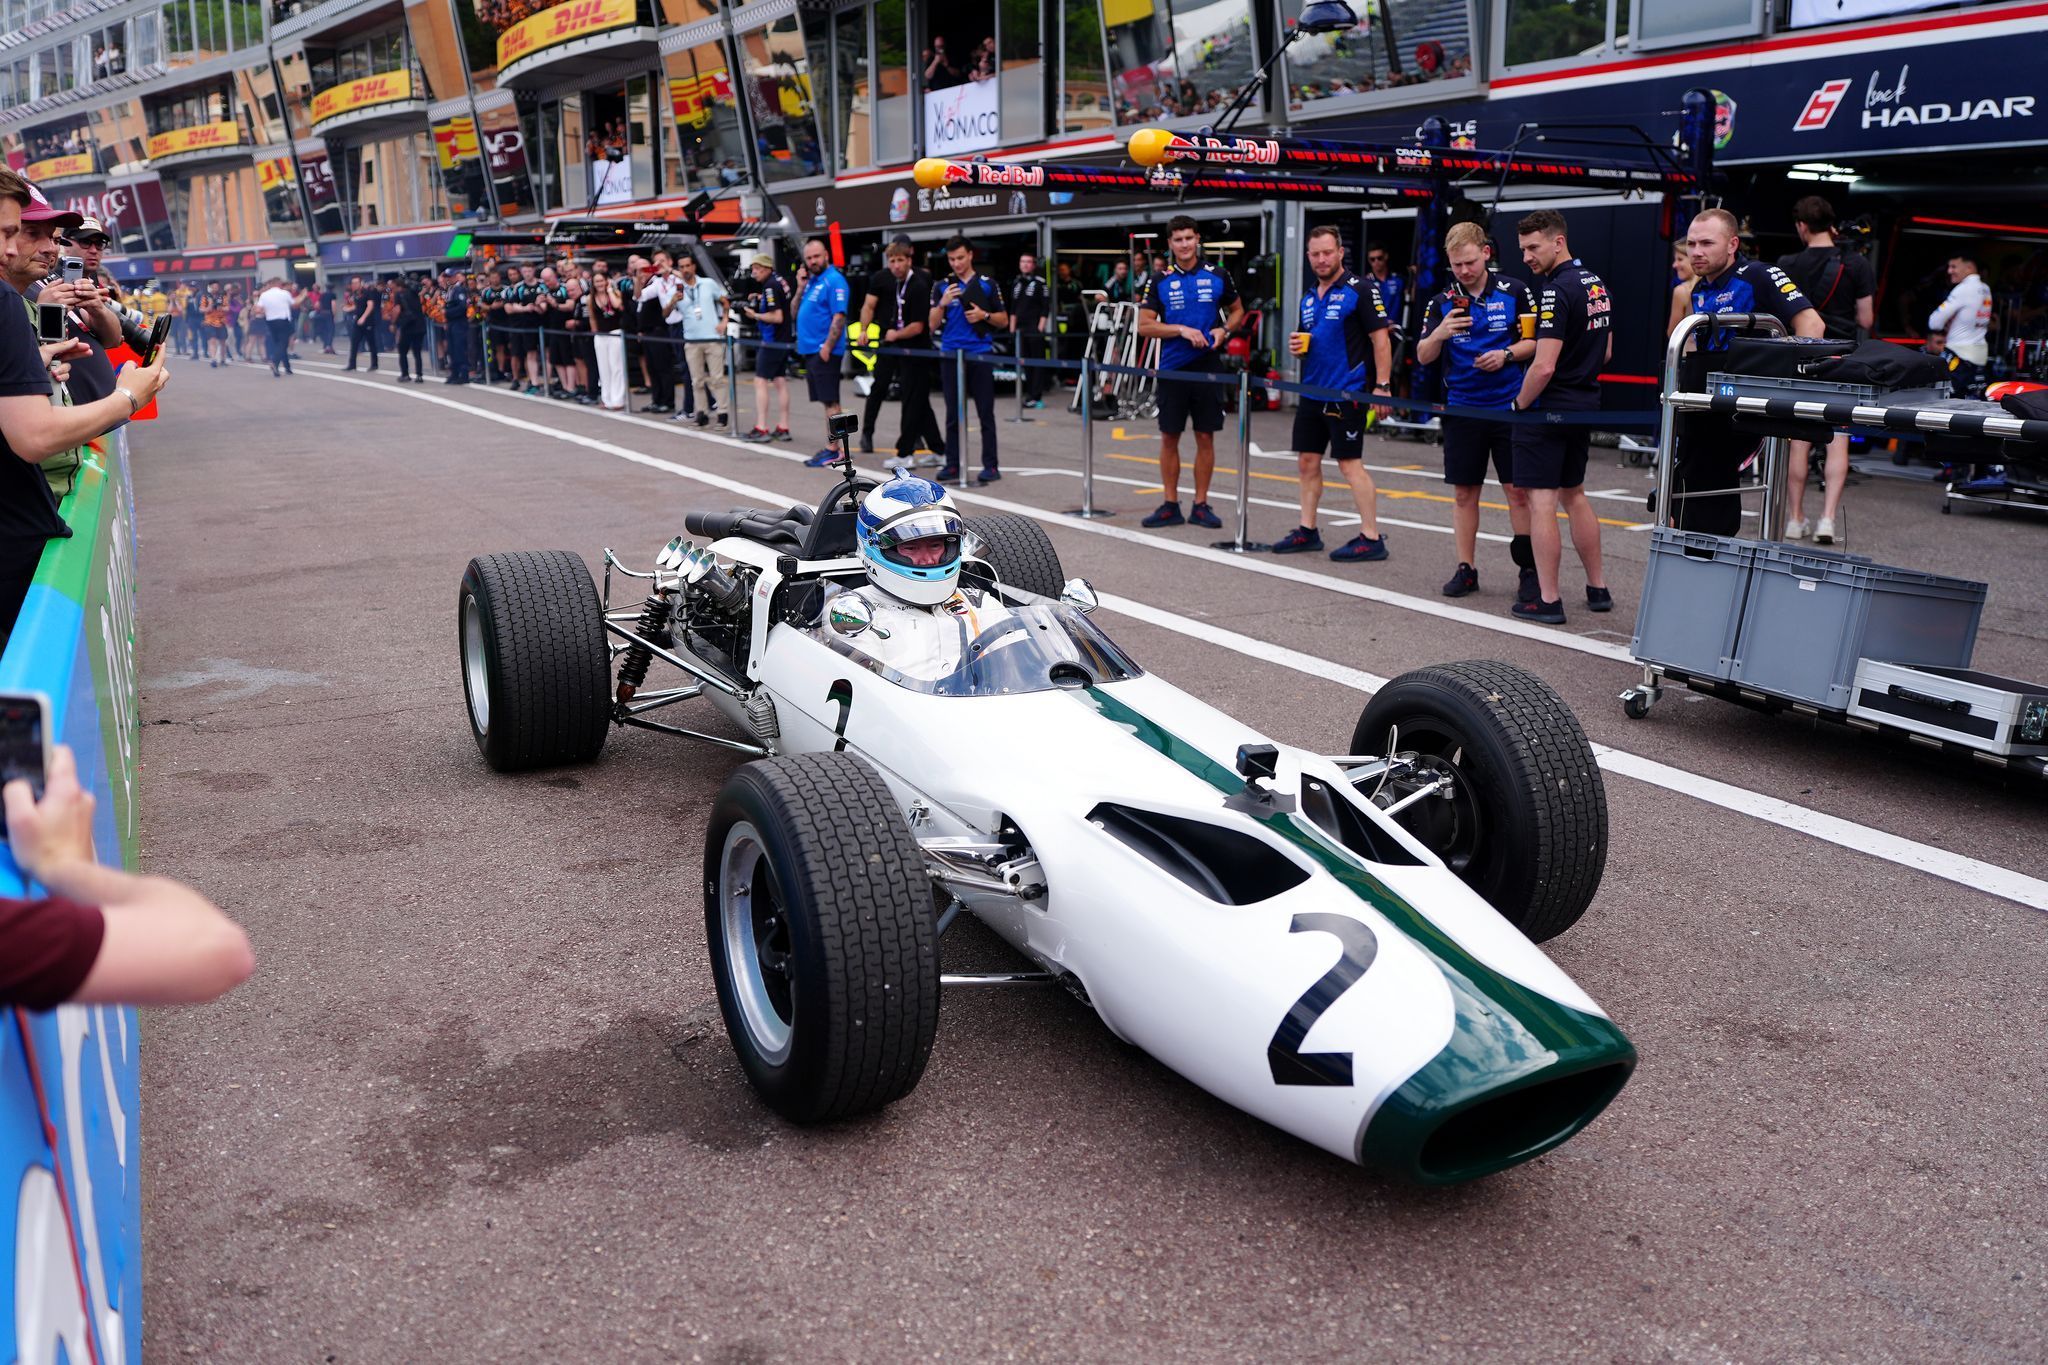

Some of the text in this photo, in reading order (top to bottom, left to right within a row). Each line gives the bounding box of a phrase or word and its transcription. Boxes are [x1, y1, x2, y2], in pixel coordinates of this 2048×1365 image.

[554, 0, 606, 35] DHL
[352, 79, 389, 103] DHL
[1793, 78, 1853, 131] 6
[1861, 96, 2036, 129] HADJAR
[188, 128, 218, 145] DHL
[934, 111, 998, 144] MONACO
[1244, 140, 1279, 165] Bull
[978, 165, 1044, 186] Red Bull
[933, 193, 997, 211] ANTONELLI
[1721, 385, 1734, 396] 16
[1267, 913, 1378, 1086] 2
